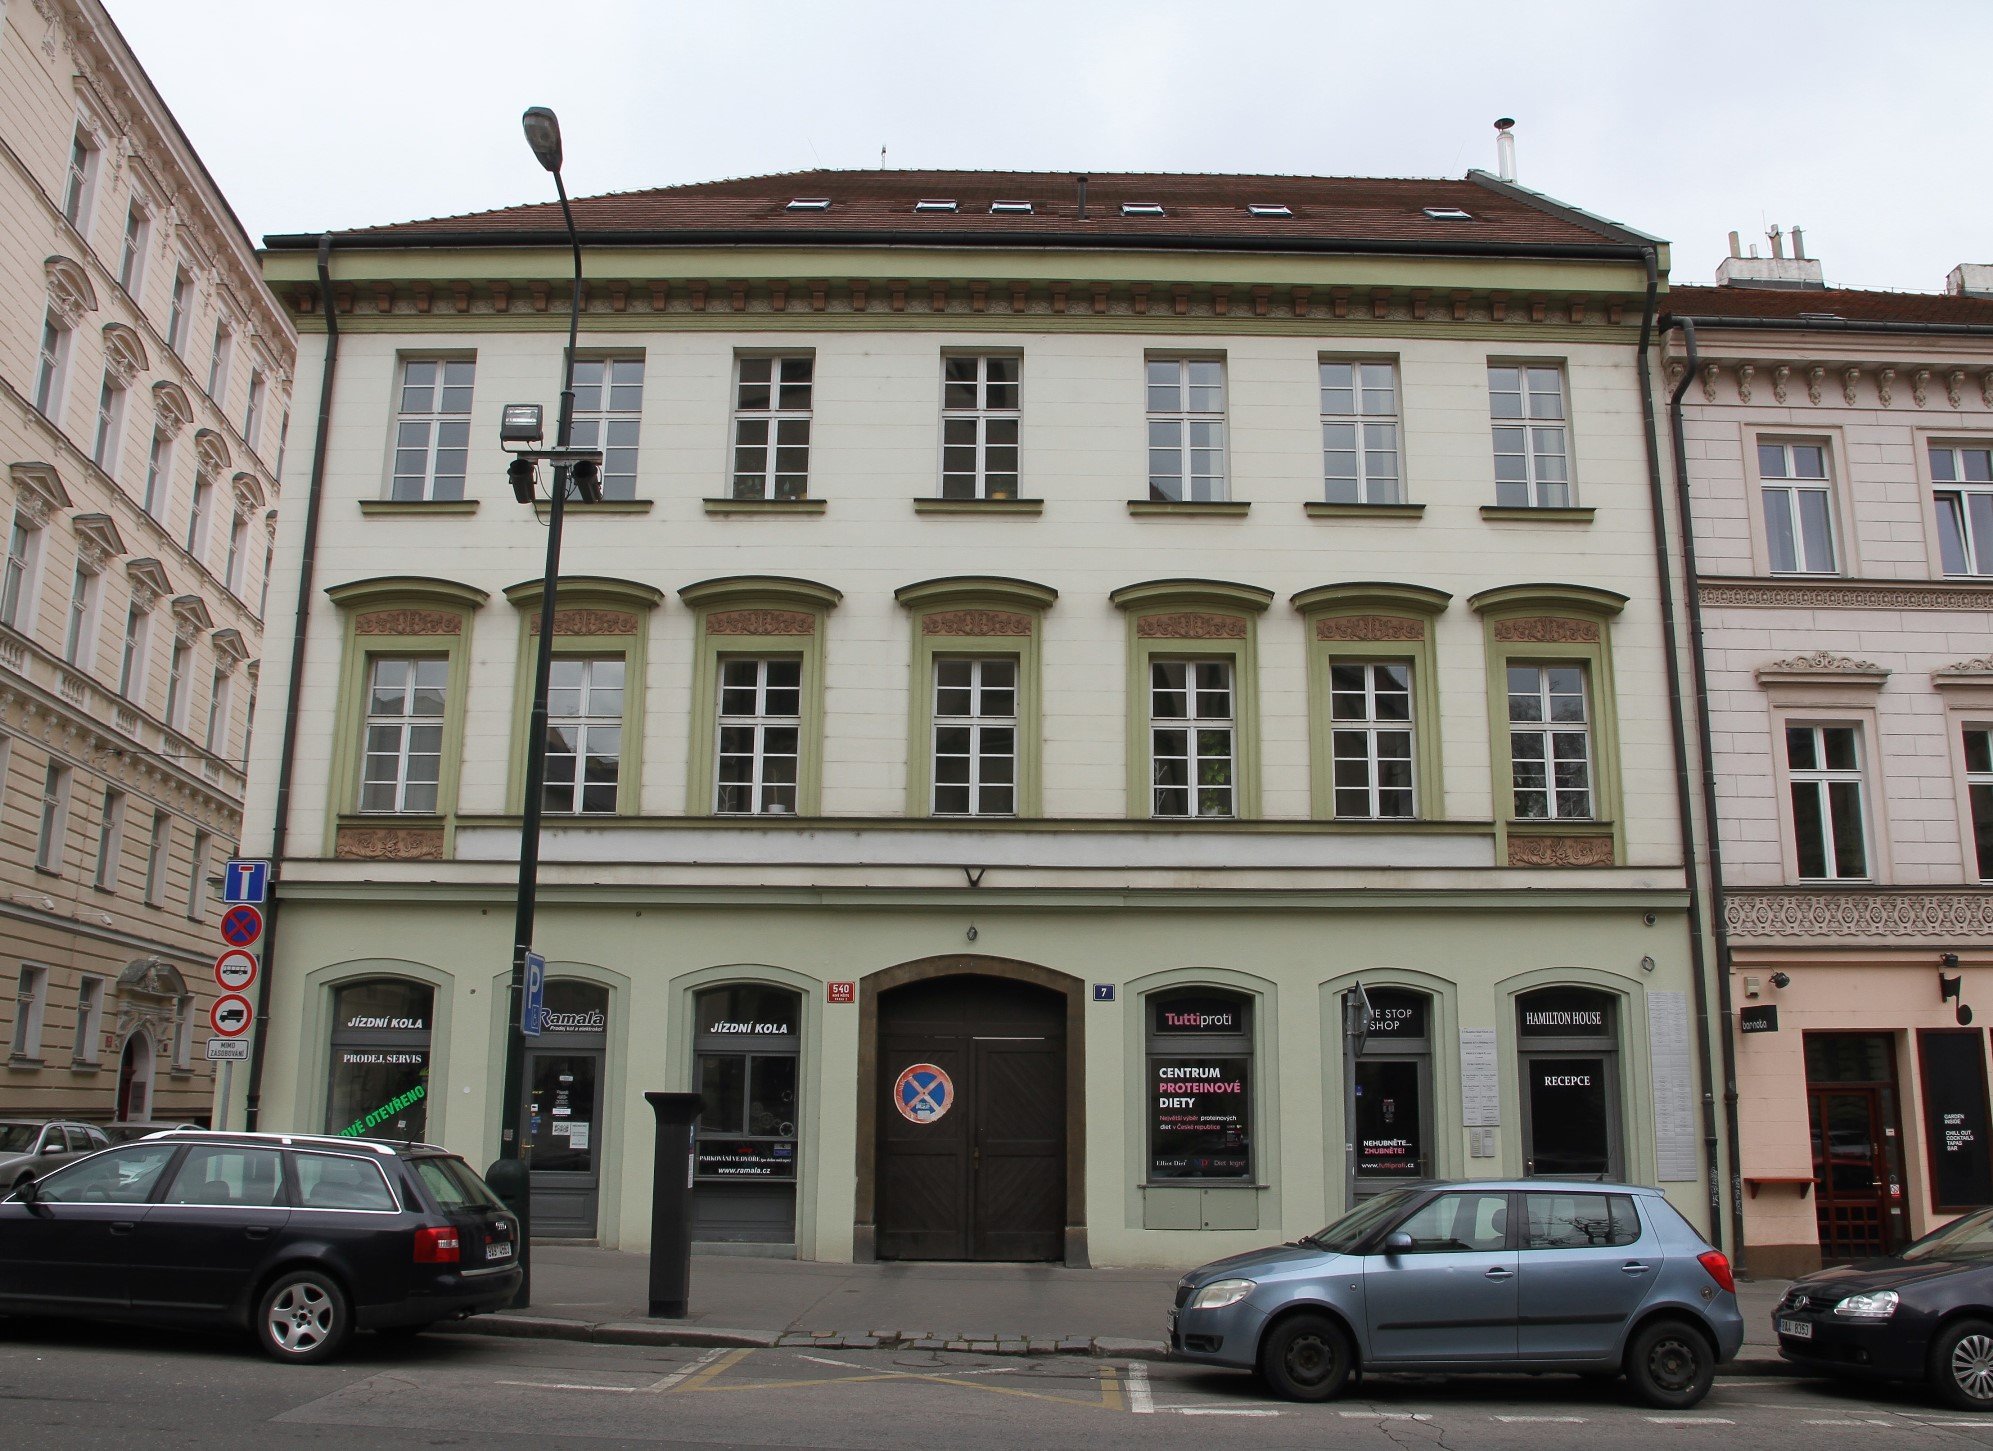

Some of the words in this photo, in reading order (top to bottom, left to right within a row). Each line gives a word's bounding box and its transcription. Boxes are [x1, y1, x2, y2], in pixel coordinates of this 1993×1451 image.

[833, 984, 850, 994] 540
[1101, 987, 1107, 997] 7
[541, 1007, 605, 1027] Ramala
[1385, 1009, 1412, 1018] STOP
[1526, 1011, 1571, 1025] HAMILTON
[1572, 1011, 1602, 1025] HOUSE
[348, 1015, 390, 1028] JÍZDNÍ
[391, 1018, 423, 1029] KOLA
[1165, 1013, 1232, 1028] Tuttiproti
[1369, 1020, 1400, 1030] SHOP
[710, 1021, 753, 1033] JÍZDNÍ
[754, 1023, 788, 1034] KOLA
[210, 1049, 245, 1057] ZÁSOBOVÁNÍ
[343, 1054, 385, 1064] PRODEJ,
[386, 1054, 422, 1064] SERVIS
[1159, 1067, 1221, 1078] CENTRUM
[1544, 1075, 1591, 1086] RECEPCE
[1159, 1080, 1241, 1093] PROTEINOVÉ
[1159, 1097, 1196, 1108] DIETY
[338, 1118, 366, 1137] OVĚ
[365, 1085, 425, 1127] OTEVŘENO
[718, 1166, 771, 1174] www.ramala.cz
